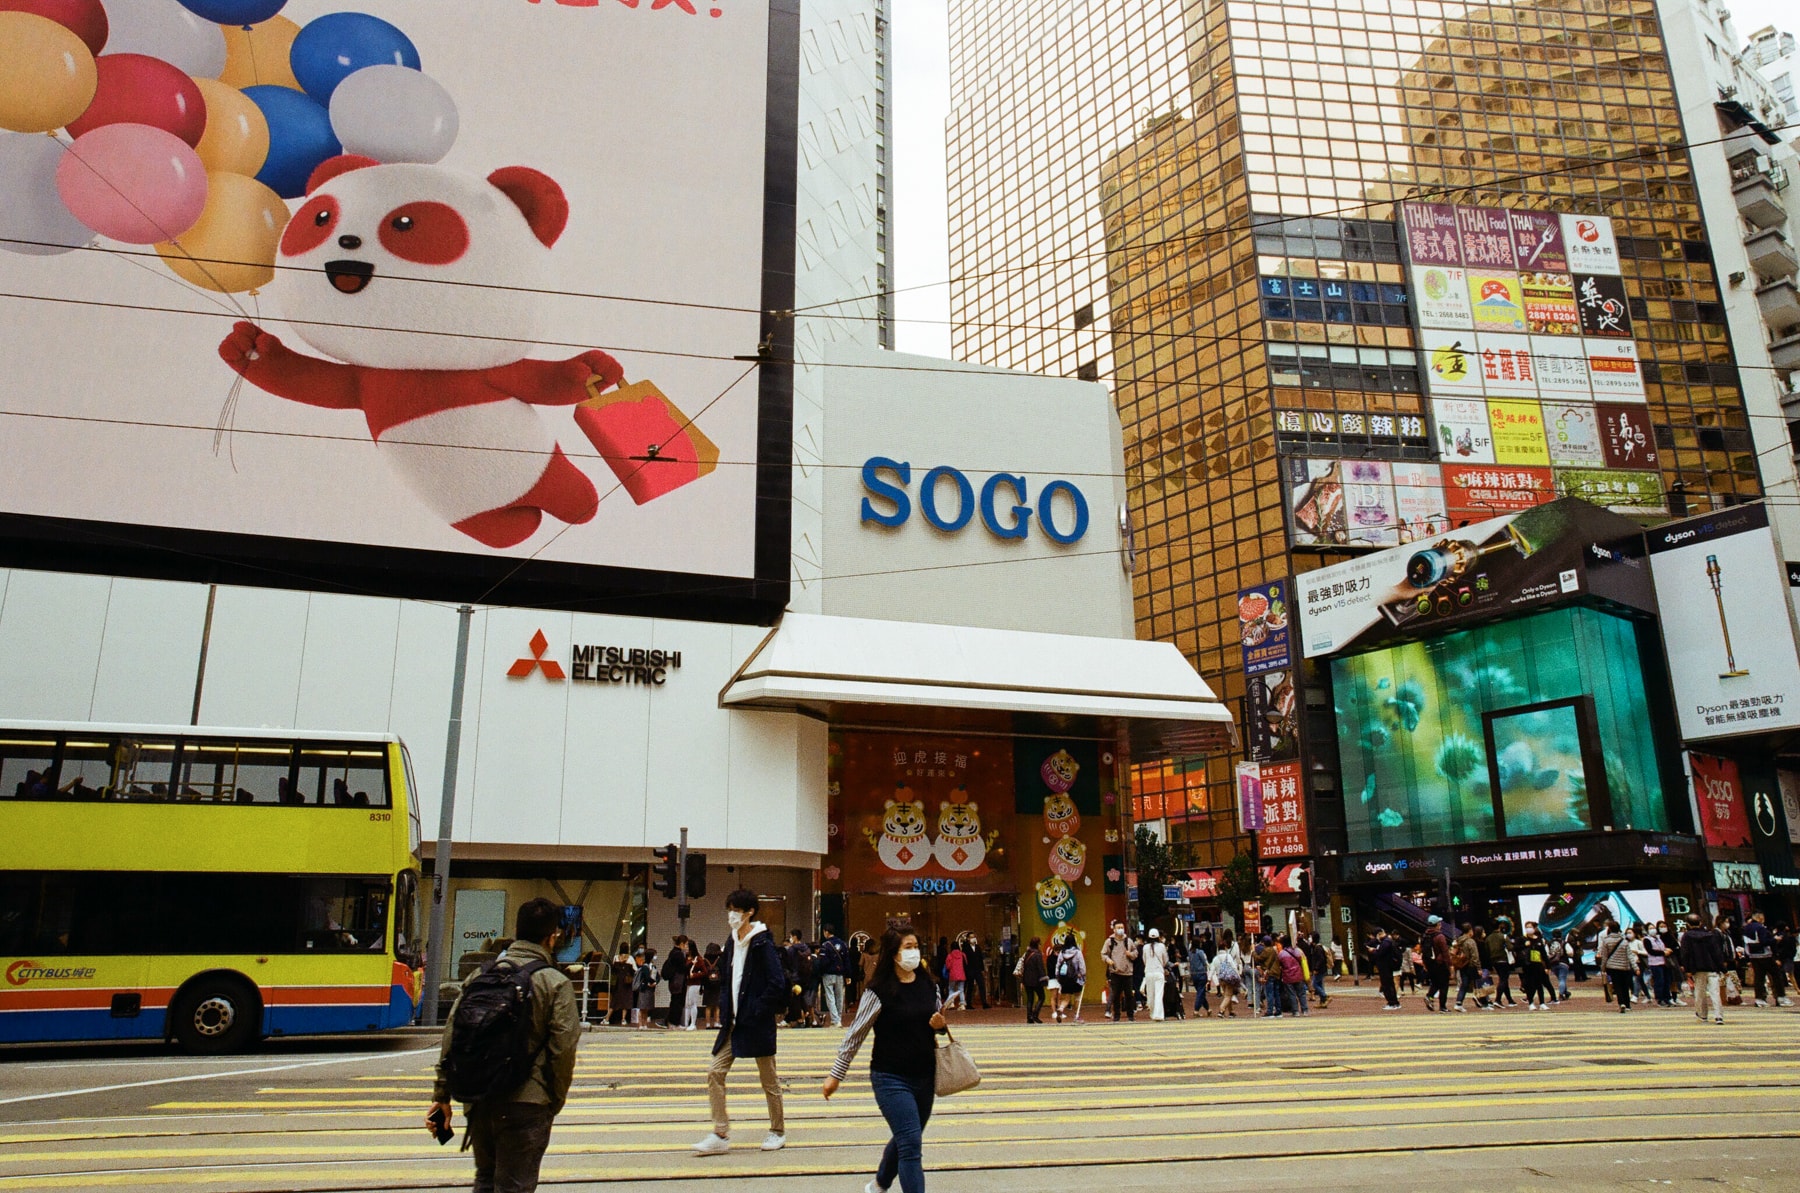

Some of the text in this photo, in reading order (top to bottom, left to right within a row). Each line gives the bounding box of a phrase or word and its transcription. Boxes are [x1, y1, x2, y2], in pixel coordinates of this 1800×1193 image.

[1405, 205, 1435, 229] THAI
[1458, 208, 1507, 233] THAI Food
[1511, 214, 1534, 231] THAI
[1447, 270, 1462, 281] 7/F
[1268, 278, 1342, 297] 富士山
[1617, 345, 1633, 354] 6/F
[1482, 347, 1534, 382] 金羅寶
[1279, 410, 1422, 437] 傷心酸辣粉
[1474, 437, 1491, 448] 5/F
[1466, 471, 1534, 489] 麻辣派對
[861, 456, 1090, 545] SOGO
[1468, 488, 1535, 501] CHILI PARTY
[1664, 529, 1696, 544] dyson
[1592, 542, 1612, 560] dyson
[1307, 576, 1371, 604] 最強勁吸力
[1510, 596, 1527, 604] works
[1526, 593, 1536, 601] like
[1540, 589, 1558, 598] Dyson
[1521, 587, 1535, 596] Only
[1539, 583, 1557, 591] Dyson
[1308, 593, 1372, 617] dyson v15 detect
[572, 644, 682, 668] MITSUBISHI
[571, 663, 667, 685] ELECTRIC
[1696, 694, 1784, 716] Dyson 最強勁吸力
[1705, 707, 1782, 726] 智能無線吸塵機
[893, 750, 969, 769] 迎虎接福
[1279, 765, 1292, 775] 4/F
[1262, 776, 1297, 801] 麻辣
[369, 813, 391, 822] 8310
[1263, 800, 1298, 824] 派對
[1262, 843, 1304, 856] 2178 4898
[1470, 853, 1503, 865] Dyson.hk
[1504, 850, 1537, 862] 直接購買
[1544, 847, 1579, 859] 免費送貨
[1643, 843, 1660, 857] dyson
[1365, 857, 1437, 874] dyson v15 detect
[912, 878, 956, 893] SOGO
[463, 930, 490, 940] OSIM
[18, 967, 96, 978] CITYBUS 城巴
